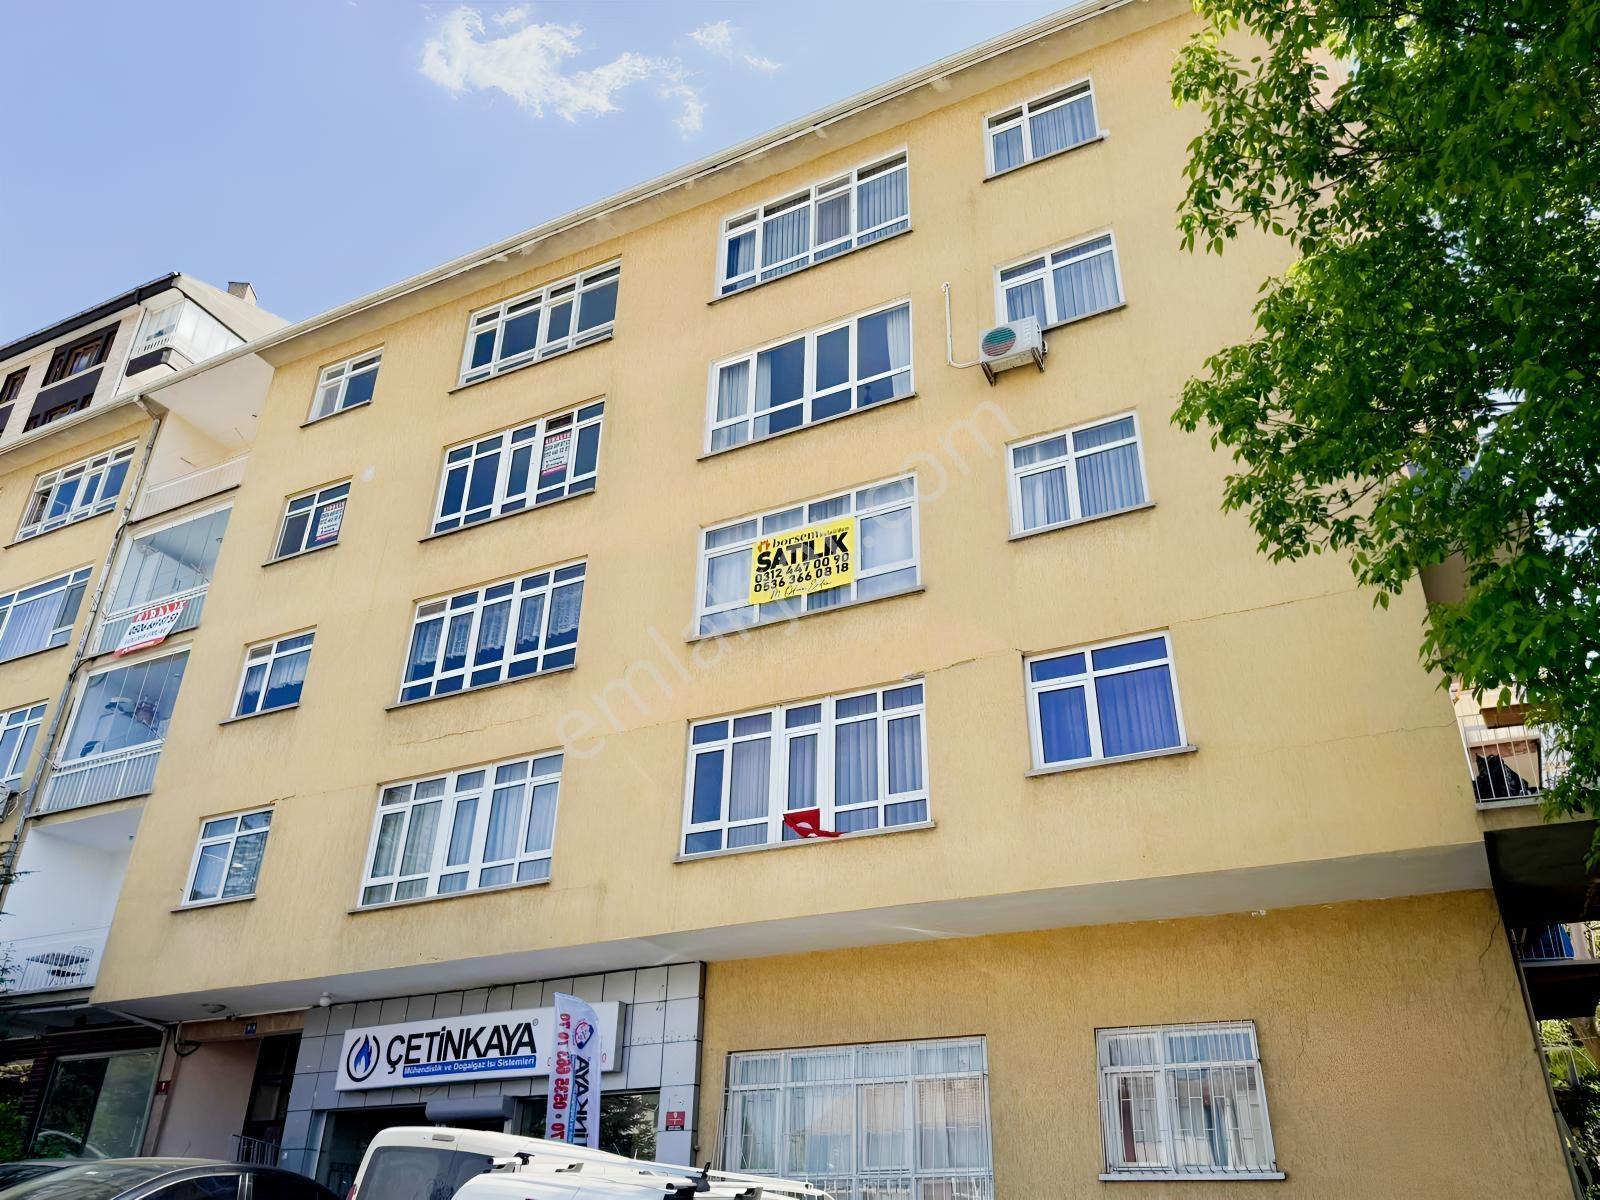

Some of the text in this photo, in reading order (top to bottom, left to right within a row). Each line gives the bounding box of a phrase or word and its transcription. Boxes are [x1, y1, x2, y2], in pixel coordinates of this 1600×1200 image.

[756, 532, 849, 573] SATILIK
[754, 578, 785, 592] 0536
[789, 572, 812, 584] 366
[836, 563, 849, 574] 18
[755, 553, 849, 583] 0312 447 00 90
[386, 1022, 537, 1074] ÇETİNKAYA
[453, 1061, 486, 1071] Doğalgaz
[497, 1057, 535, 1067] Sistemleri
